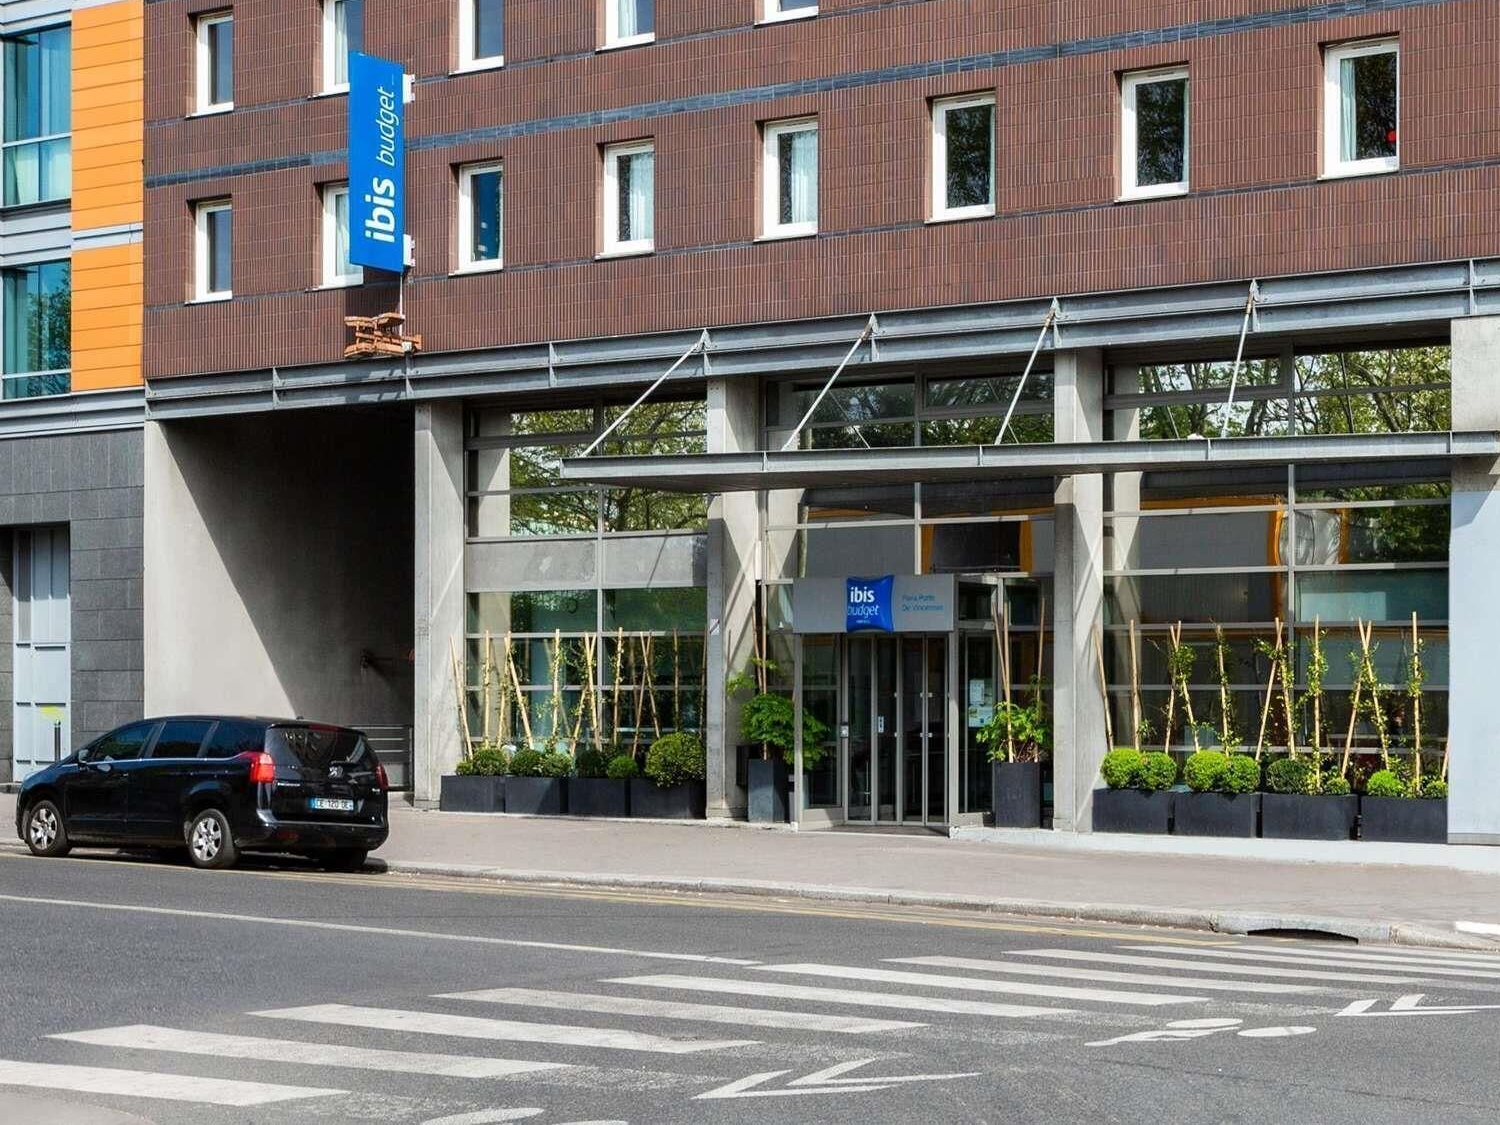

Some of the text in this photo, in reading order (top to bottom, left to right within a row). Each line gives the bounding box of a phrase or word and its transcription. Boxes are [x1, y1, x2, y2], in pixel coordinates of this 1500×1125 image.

[365, 86, 399, 242] ibis budget
[850, 587, 875, 603] ibis
